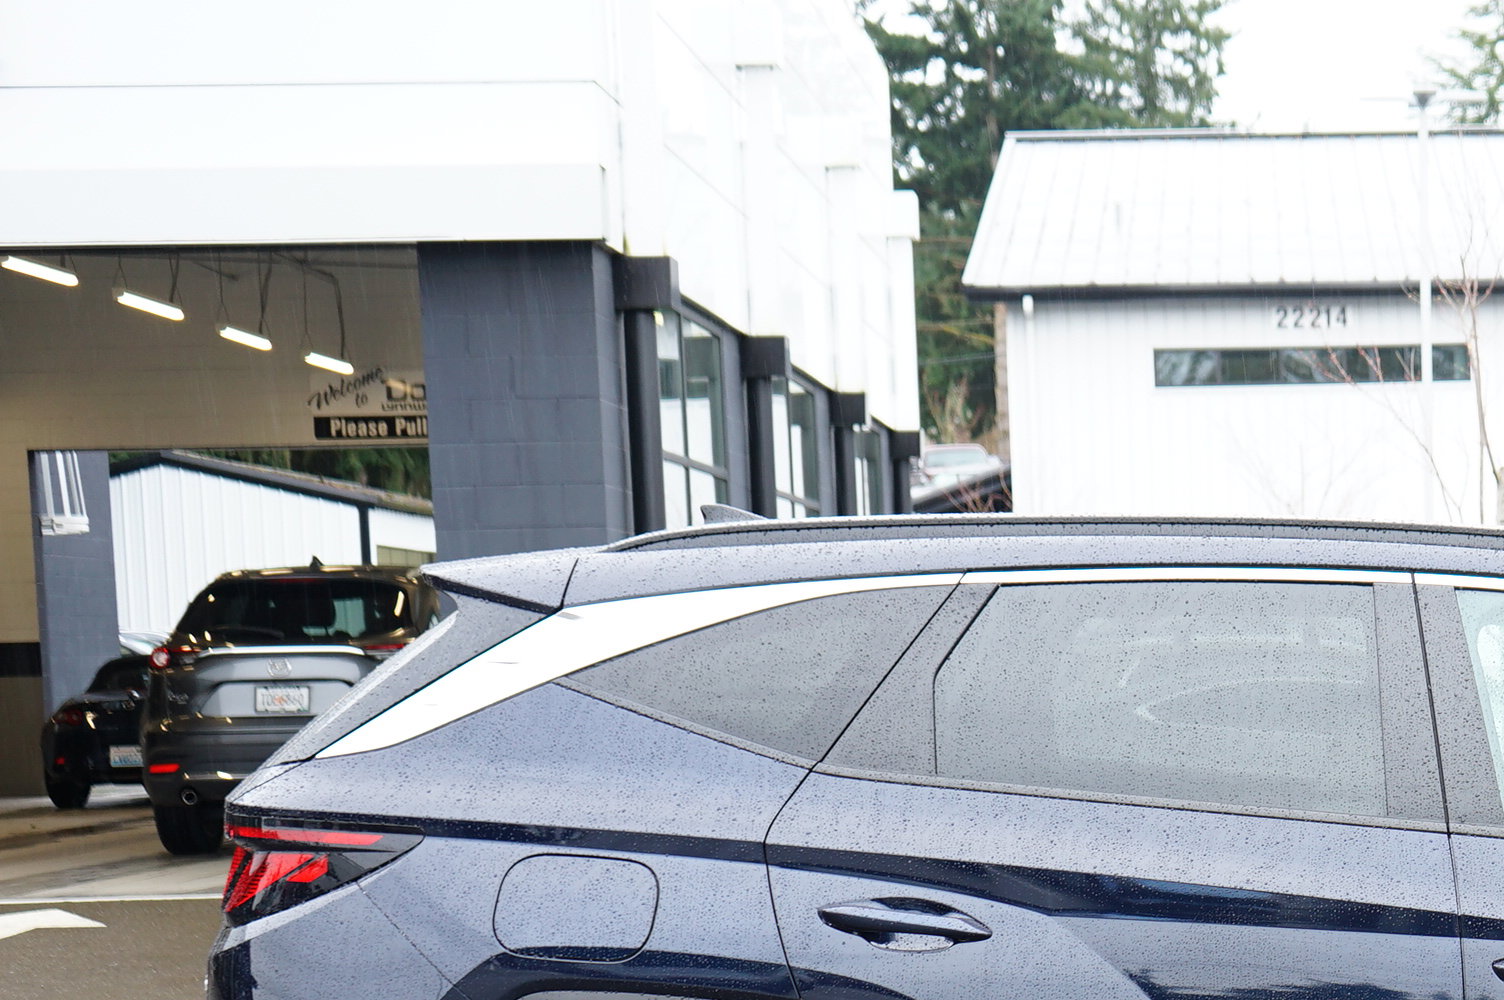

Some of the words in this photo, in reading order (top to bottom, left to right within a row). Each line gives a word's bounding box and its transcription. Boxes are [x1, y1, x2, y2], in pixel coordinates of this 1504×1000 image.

[1277, 305, 1347, 328] 22214
[307, 366, 387, 411] Welcome
[355, 391, 369, 409] to
[330, 417, 389, 438] Please
[395, 416, 428, 437] Pull
